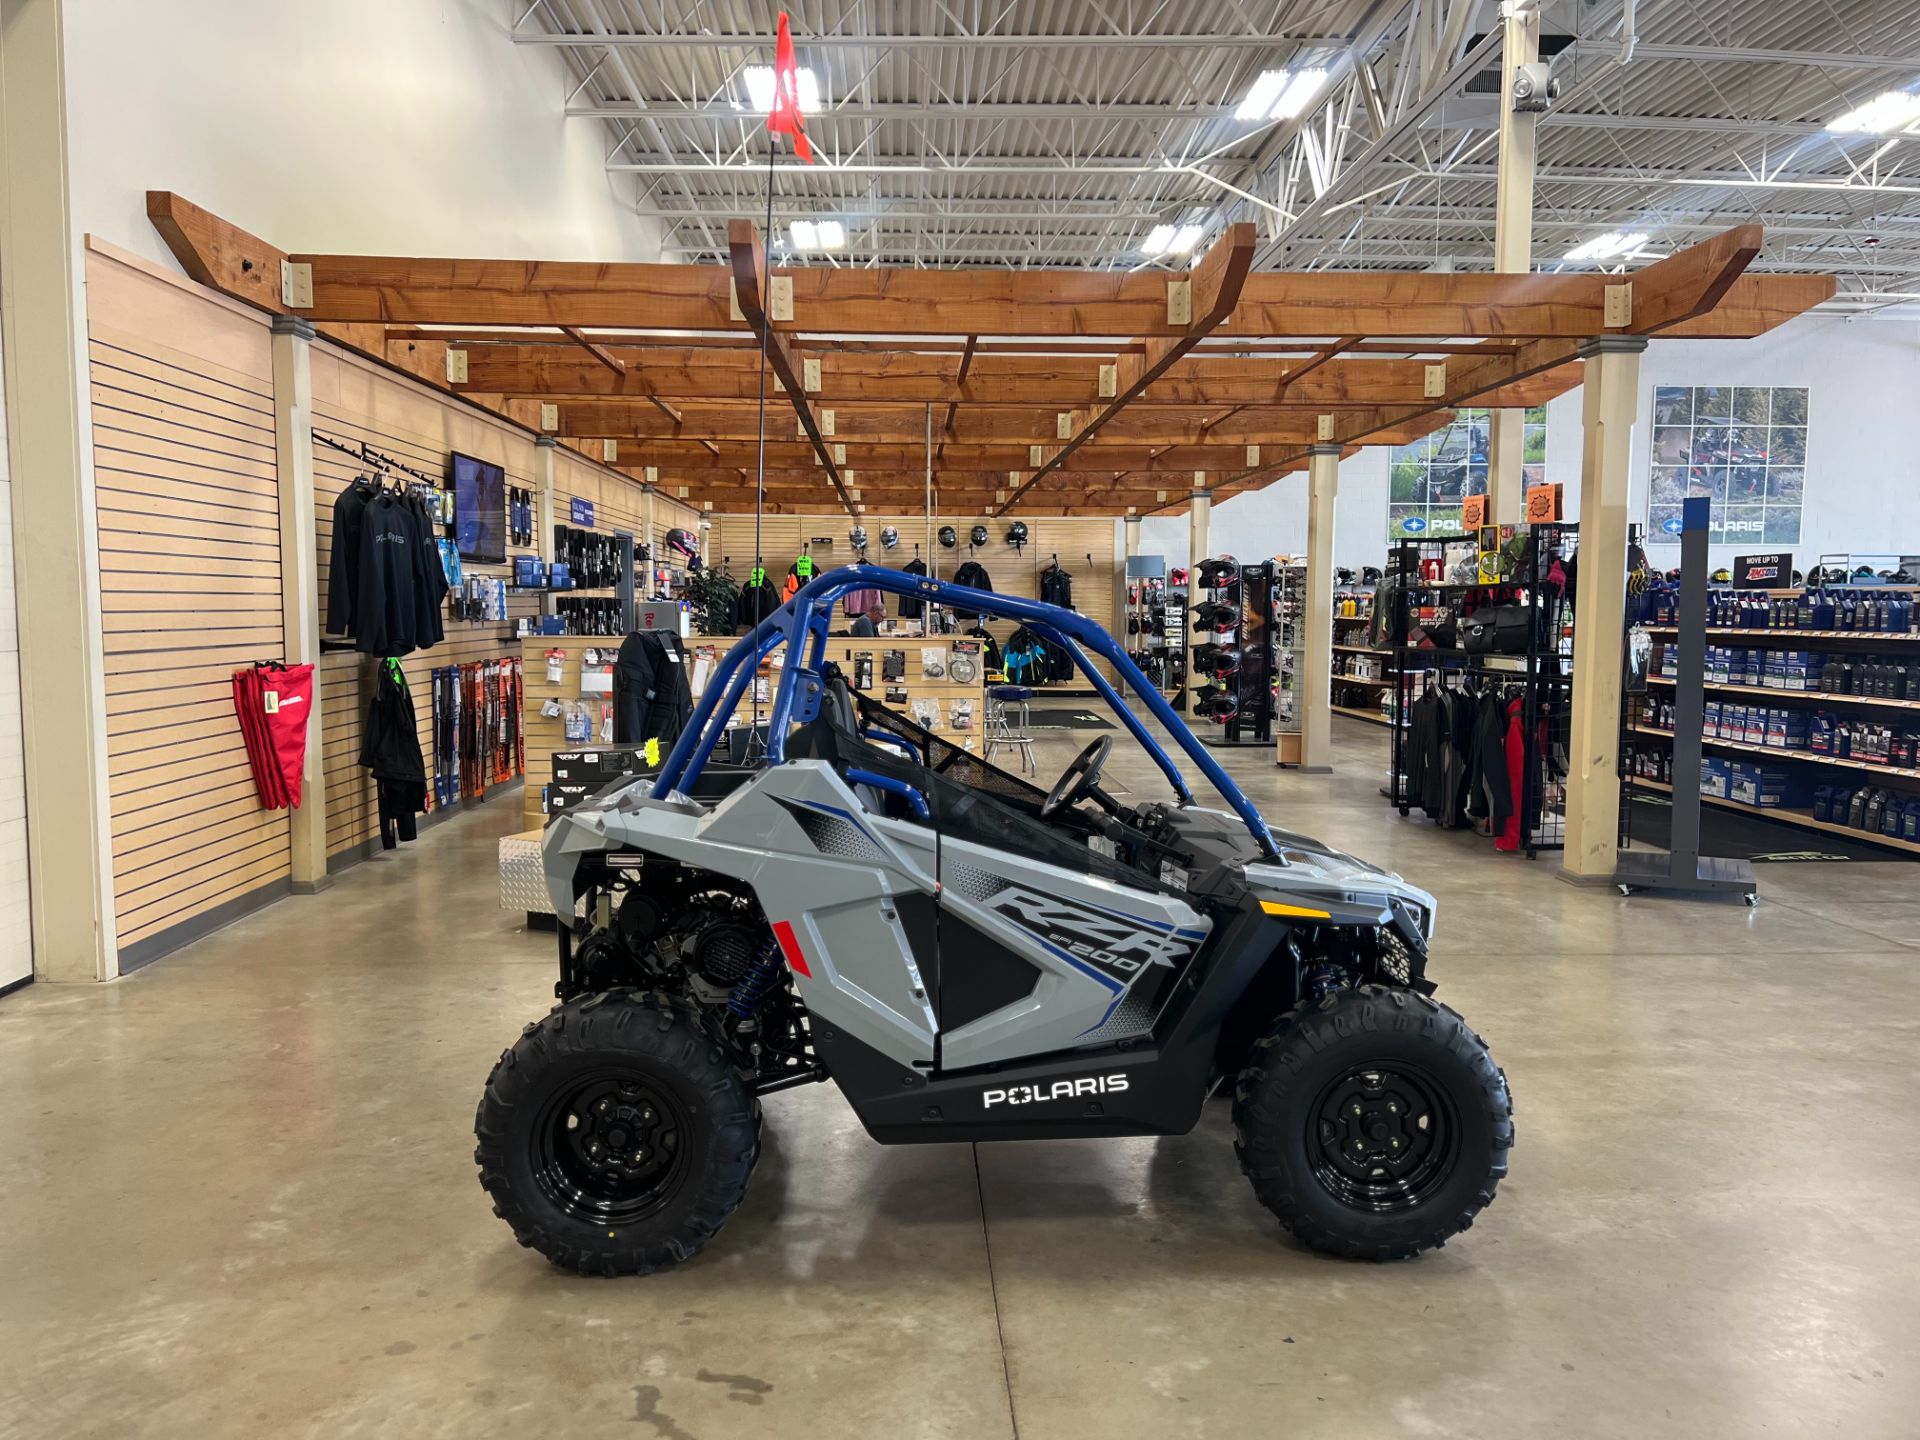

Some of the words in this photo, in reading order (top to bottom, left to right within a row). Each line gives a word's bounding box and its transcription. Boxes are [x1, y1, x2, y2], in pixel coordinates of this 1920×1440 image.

[1709, 521, 1763, 531] OLARIS
[1746, 567, 1778, 580] AMSOIL
[984, 886, 1191, 968] RZR
[1068, 942, 1141, 971] 200
[983, 1073, 1129, 1109] POLARIS
